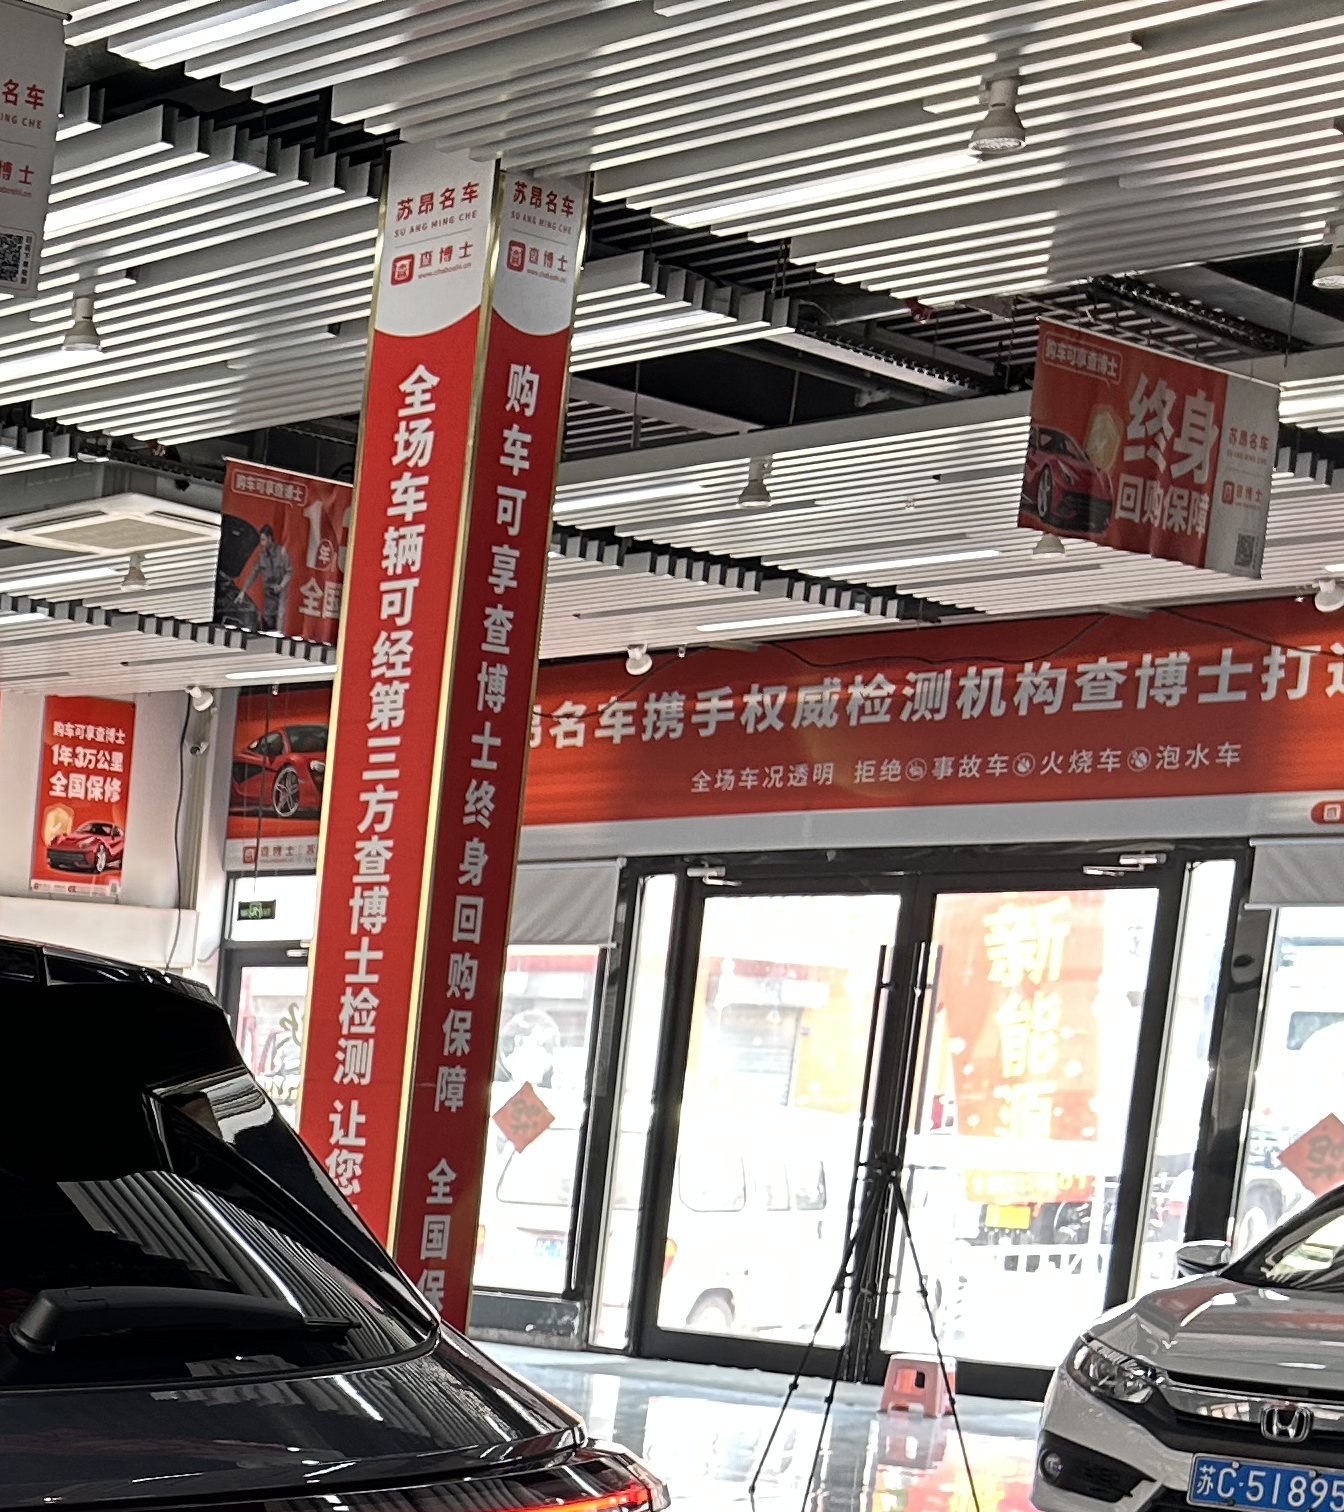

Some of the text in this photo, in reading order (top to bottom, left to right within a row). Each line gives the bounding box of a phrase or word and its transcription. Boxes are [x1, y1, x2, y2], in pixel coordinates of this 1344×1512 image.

[395, 181, 480, 222] 苏昂名车
[513, 180, 575, 218] 苏昂名车
[418, 241, 474, 269] 查博士
[1045, 338, 1119, 378] 购车可享查博士
[1123, 372, 1219, 485] 终身
[1115, 474, 1210, 537] 回购保障
[49, 770, 122, 803] 全国保修
[690, 741, 1242, 793] 全场车况透明 拒绝 事故车 火烧车 泡水车
[325, 1099, 368, 1205] 让您
